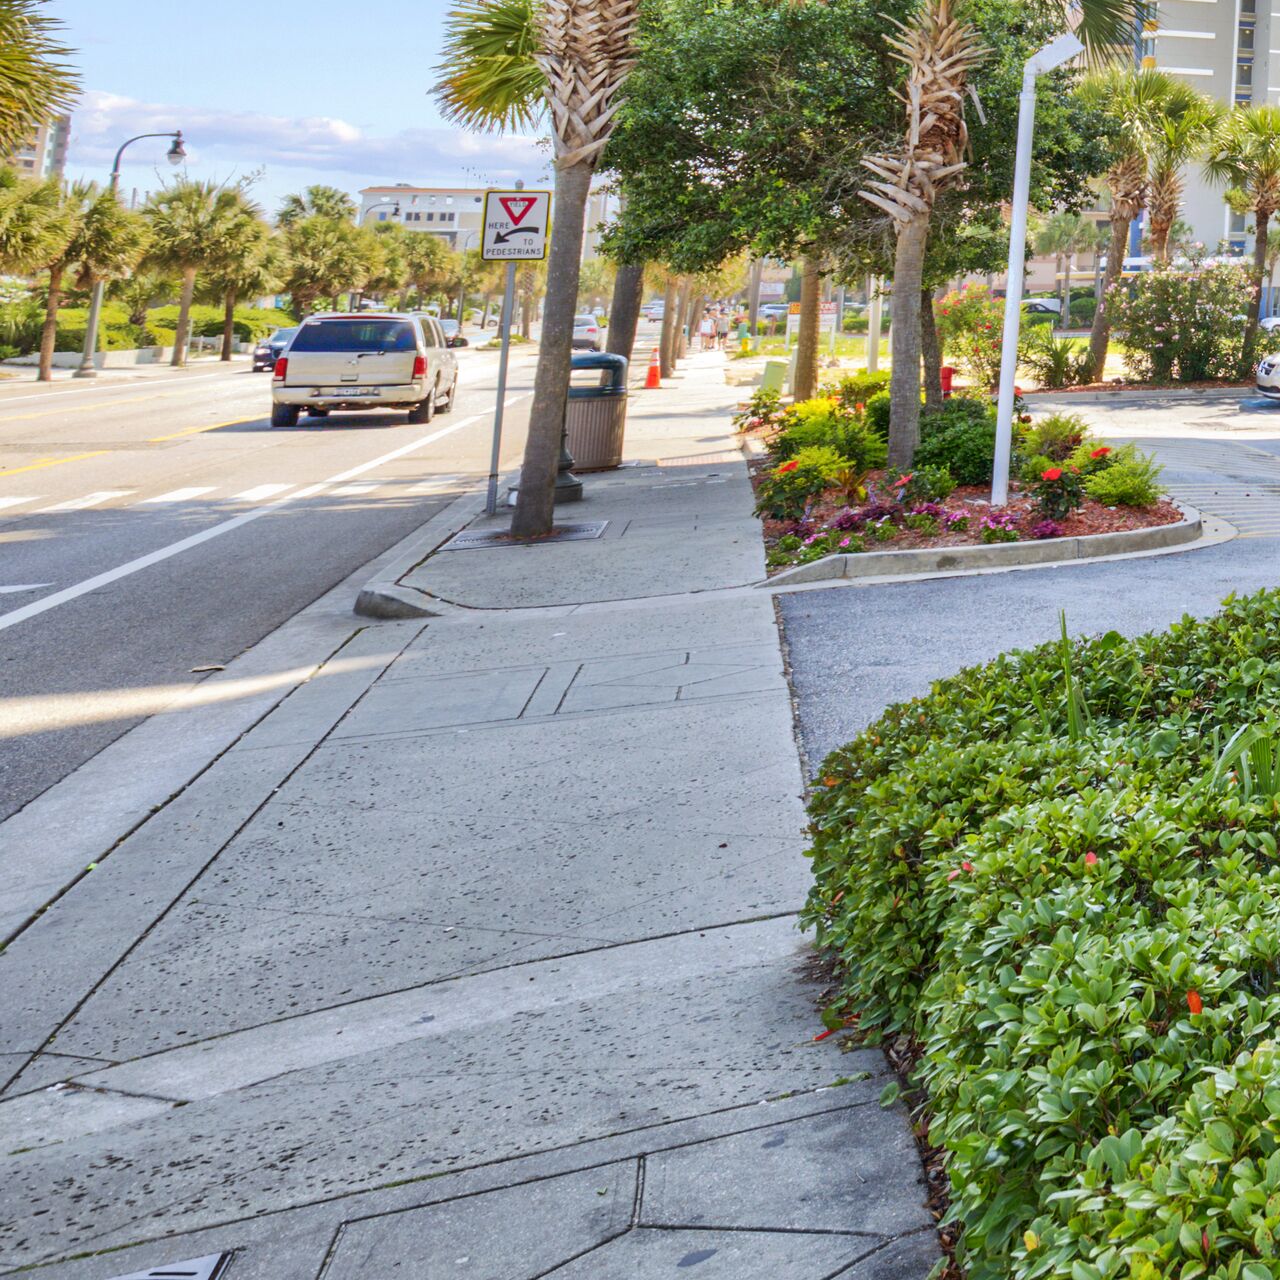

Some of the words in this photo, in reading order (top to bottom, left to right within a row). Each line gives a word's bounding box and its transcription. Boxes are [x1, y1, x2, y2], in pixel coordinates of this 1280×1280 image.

[488, 222, 510, 230] HERE
[523, 238, 534, 246] TO
[486, 247, 542, 256] PEDESTRIANS
